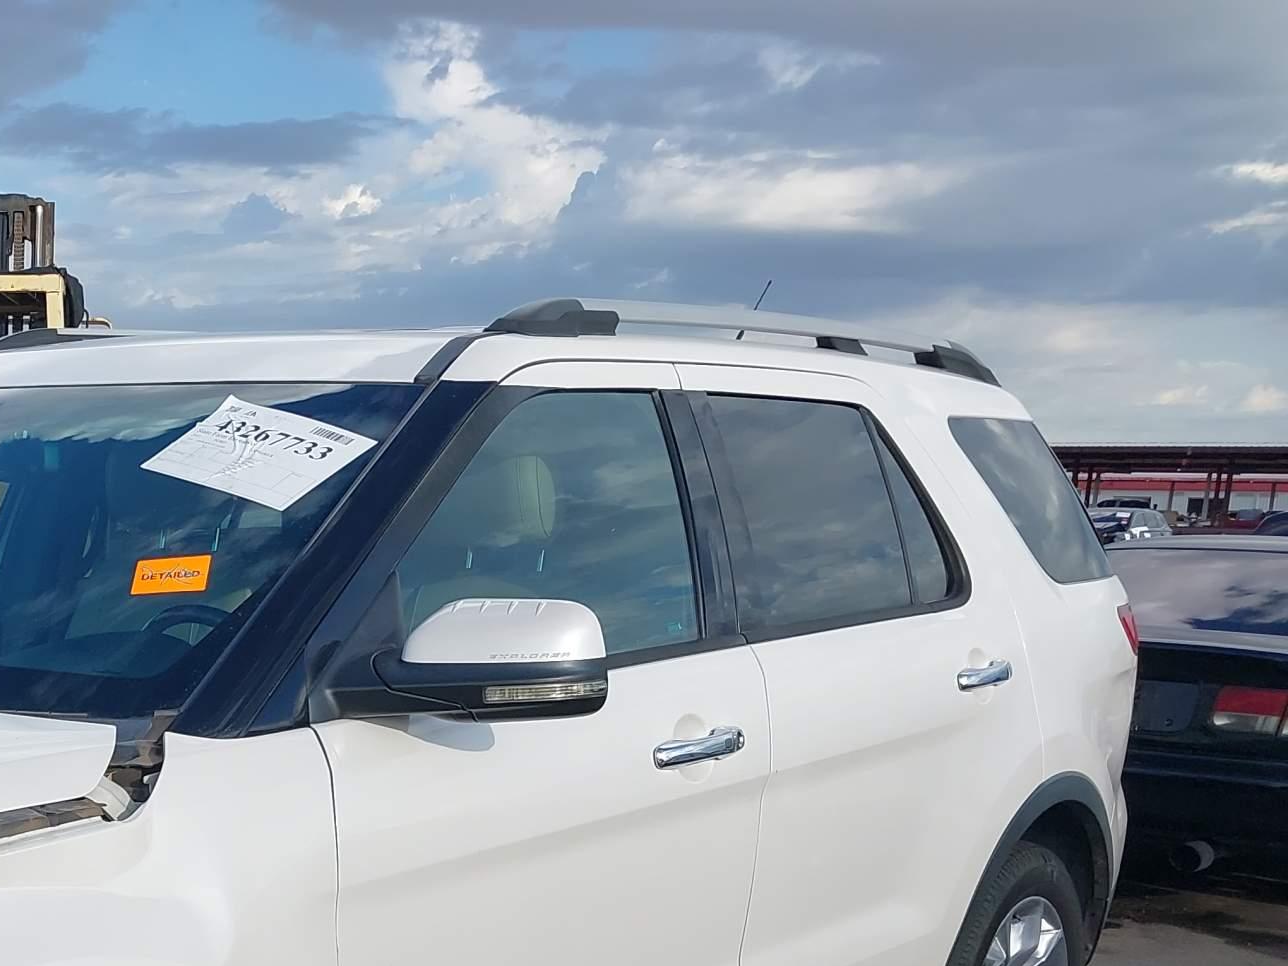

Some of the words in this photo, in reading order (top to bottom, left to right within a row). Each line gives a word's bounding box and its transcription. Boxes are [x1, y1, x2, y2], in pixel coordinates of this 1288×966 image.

[215, 419, 334, 460] 43267733
[141, 570, 201, 581] DETAILED
[488, 651, 571, 660] EXPLORER
